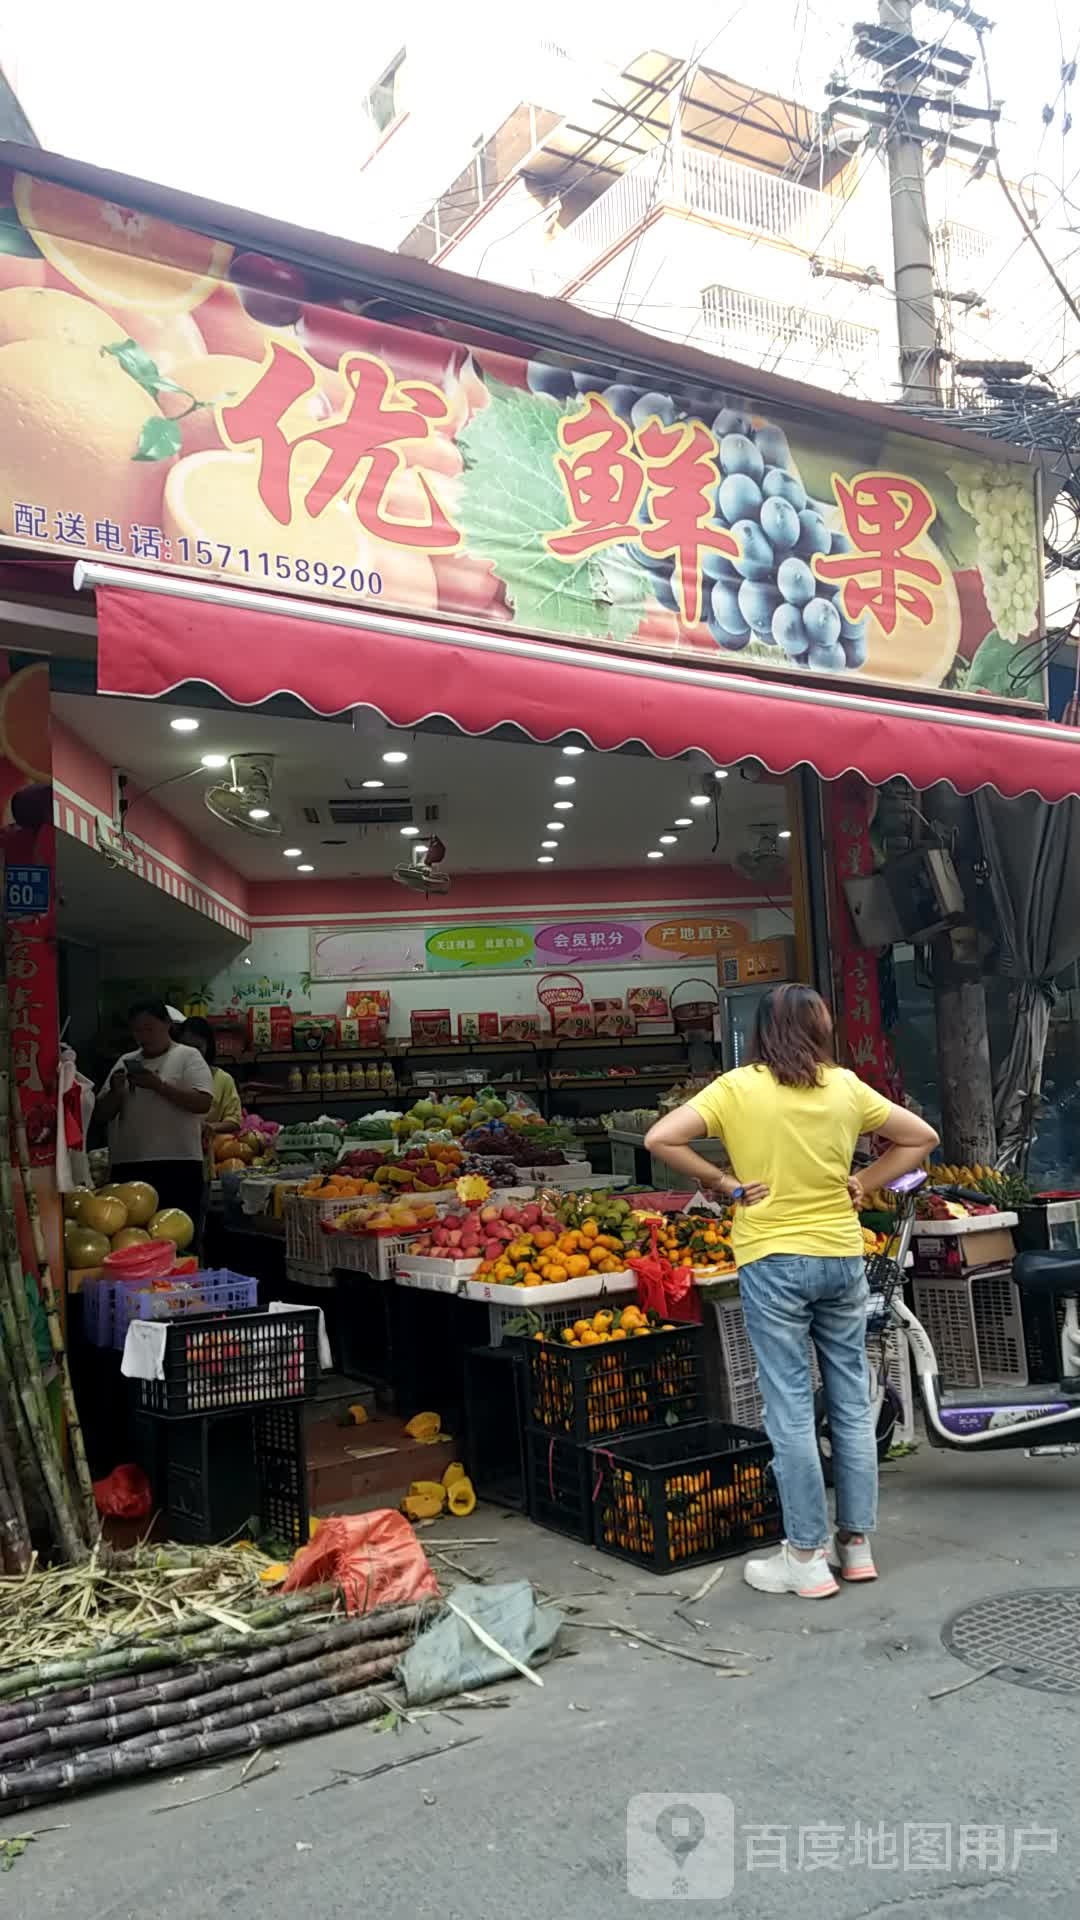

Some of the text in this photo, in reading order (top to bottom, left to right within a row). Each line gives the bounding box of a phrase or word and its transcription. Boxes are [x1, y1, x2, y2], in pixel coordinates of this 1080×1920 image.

[218, 338, 946, 637] 优鲜果
[14, 503, 383, 595] 配送电话:15711589200
[553, 931, 624, 947] 会员积分
[661, 926, 733, 941] 产地直达
